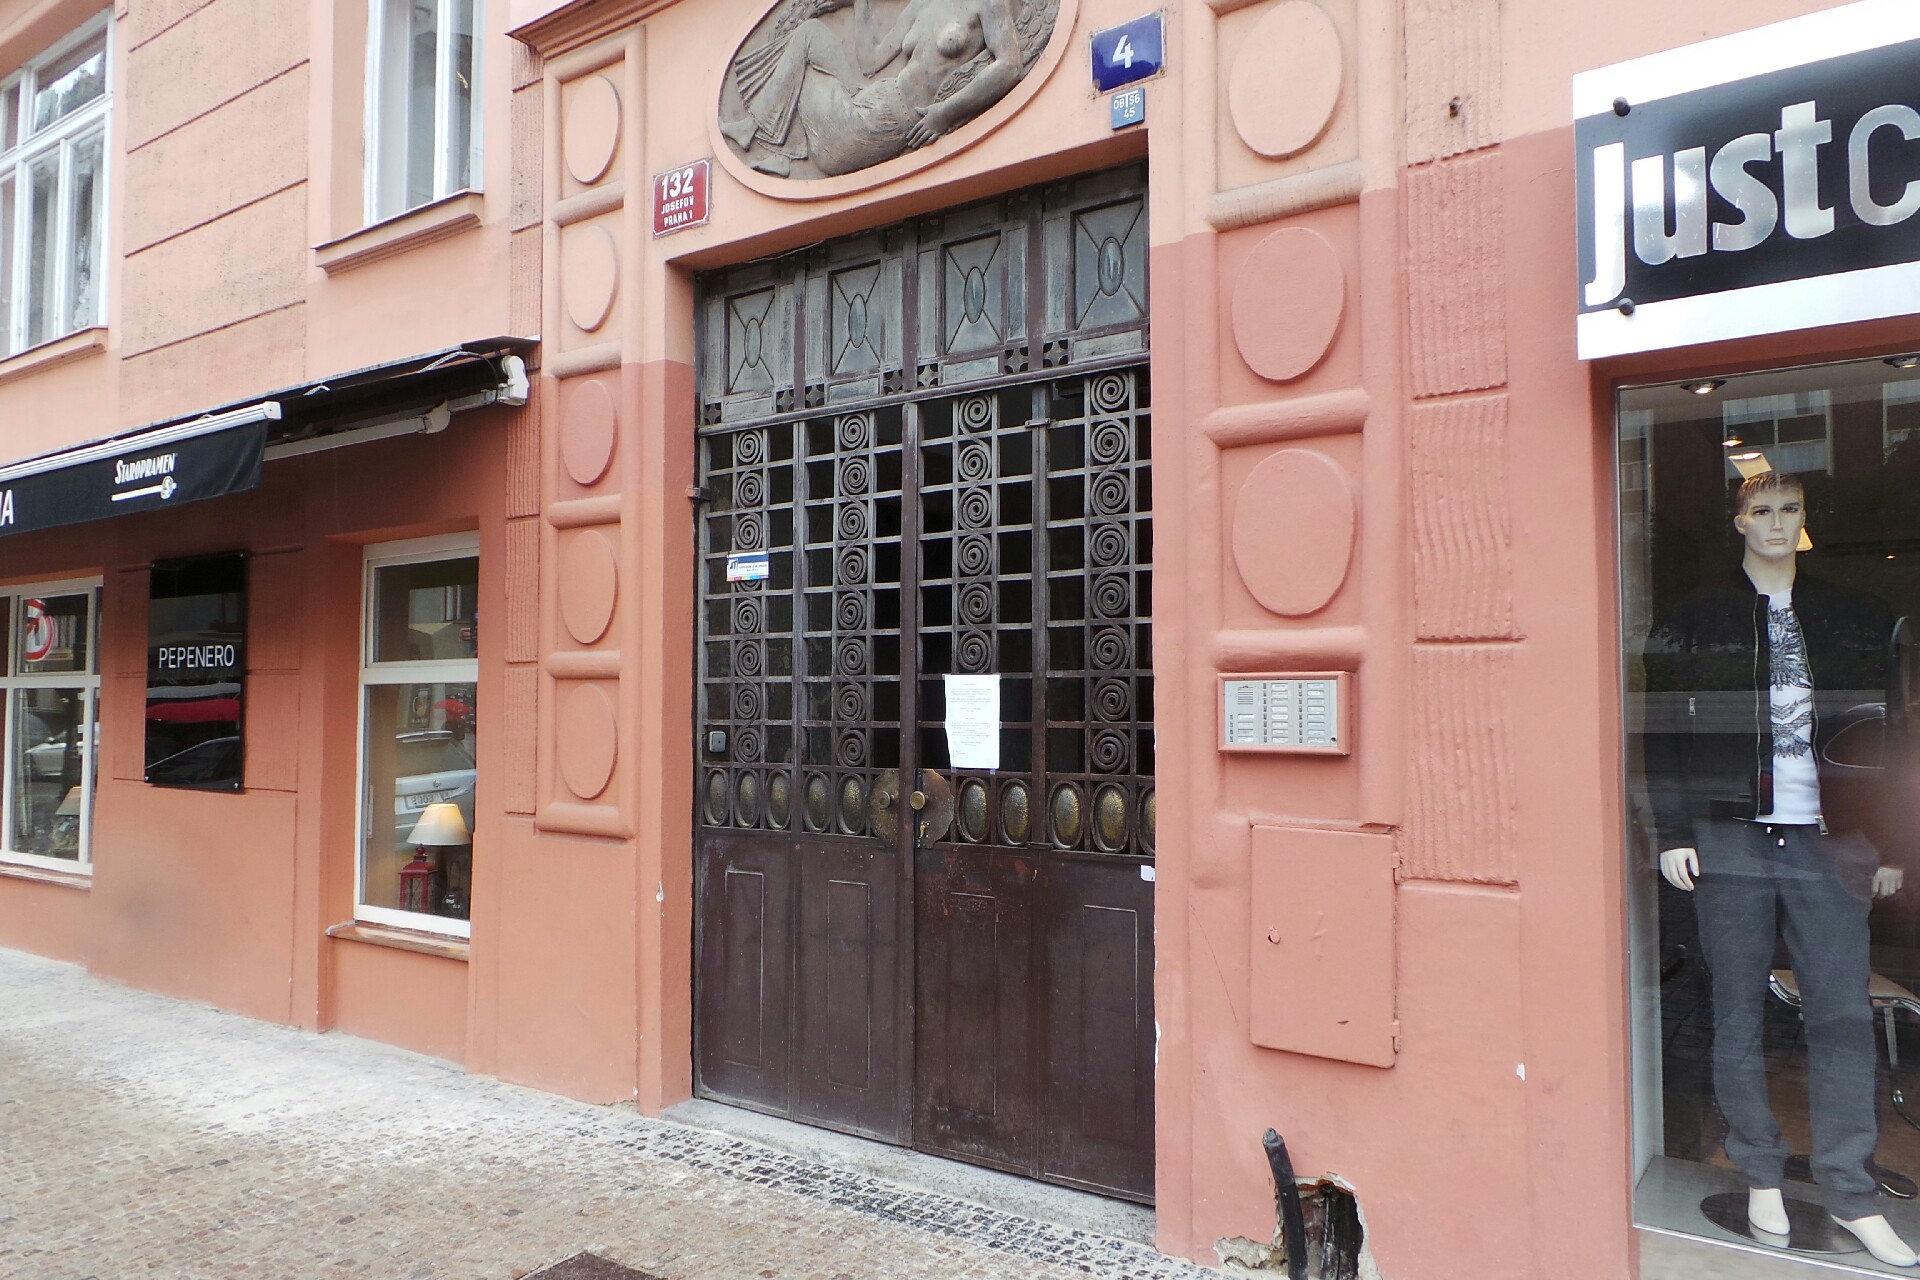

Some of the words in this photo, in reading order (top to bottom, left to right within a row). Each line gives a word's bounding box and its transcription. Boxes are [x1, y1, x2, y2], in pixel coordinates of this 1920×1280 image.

[1112, 34, 1134, 69] 4
[661, 167, 694, 201] 132
[661, 195, 694, 215] JOSEFOV
[664, 211, 688, 227] PRAHA
[689, 209, 693, 220] 1
[158, 644, 235, 669] PEPENERO
